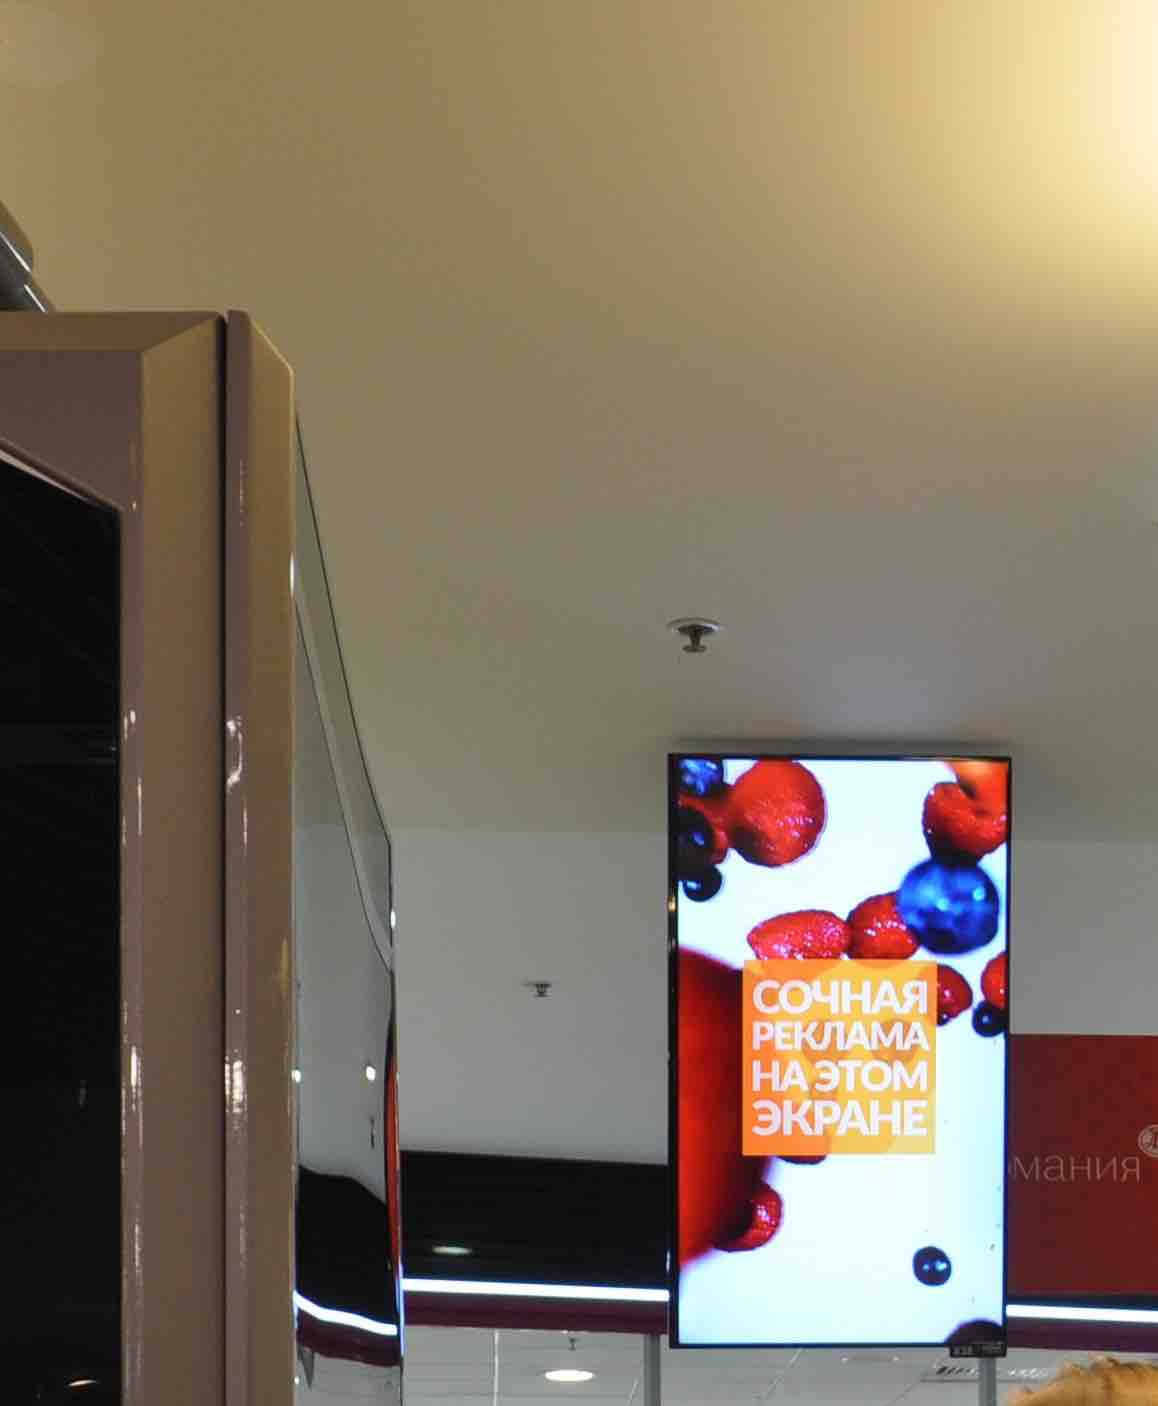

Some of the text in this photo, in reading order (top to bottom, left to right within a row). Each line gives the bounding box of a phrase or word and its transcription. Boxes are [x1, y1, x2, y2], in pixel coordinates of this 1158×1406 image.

[752, 979, 928, 1015] СОЧНАЯ
[751, 1020, 931, 1051] РЕКЛАМА
[752, 1059, 929, 1093] НА ЭТОМ
[752, 1099, 929, 1137] ЭКРАНЕ
[1008, 1154, 1142, 1183] мания
